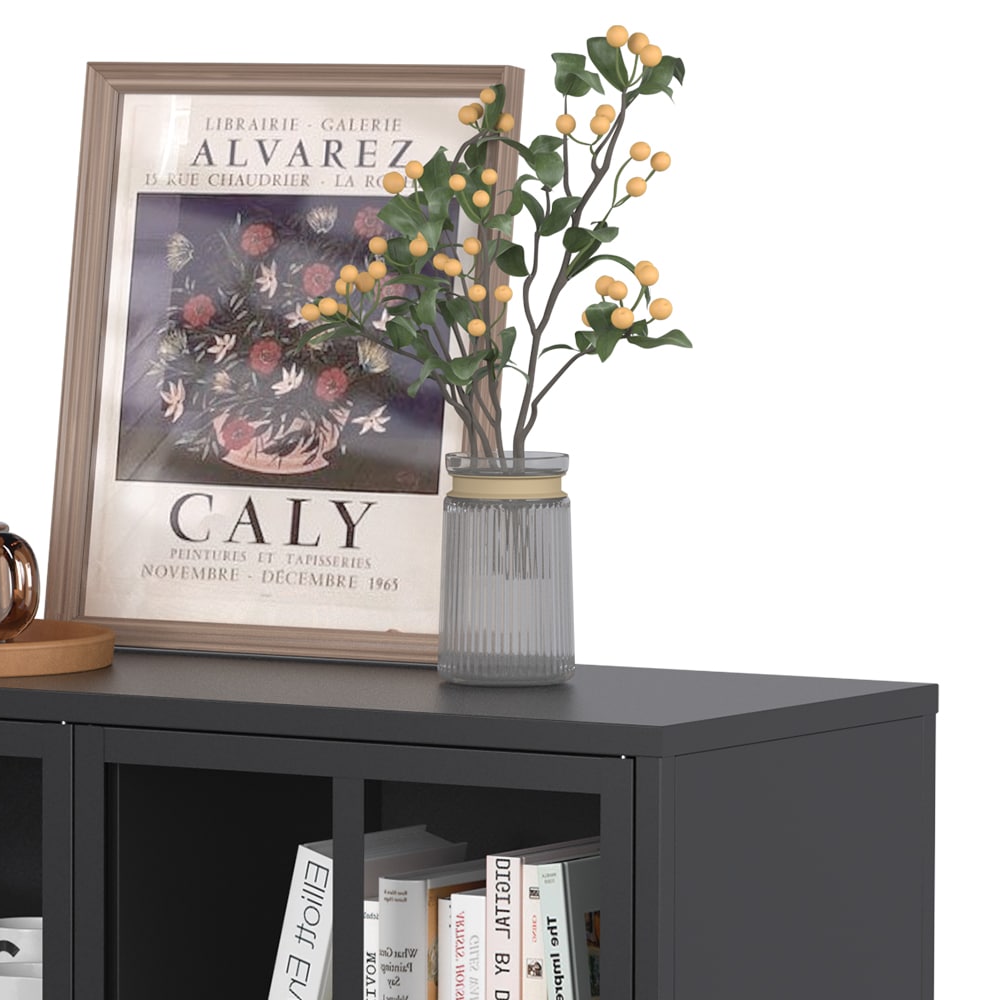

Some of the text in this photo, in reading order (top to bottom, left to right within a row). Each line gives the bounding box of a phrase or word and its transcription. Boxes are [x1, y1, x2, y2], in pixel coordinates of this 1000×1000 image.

[205, 117, 299, 132] LIBRAIRIE
[321, 117, 402, 132] GALERIE
[189, 138, 414, 169] ALVAREZ
[145, 173, 158, 187] 15
[167, 173, 199, 187] RUE
[208, 173, 310, 188] CHAUDRIER
[335, 174, 355, 188] LA
[169, 492, 378, 550] CALY
[170, 548, 372, 570] PEINTURES ET TAPISSERIES
[141, 564, 239, 582] NOVEMBRE
[261, 568, 357, 590] DÉCEMBRE
[369, 577, 399, 592] 1965
